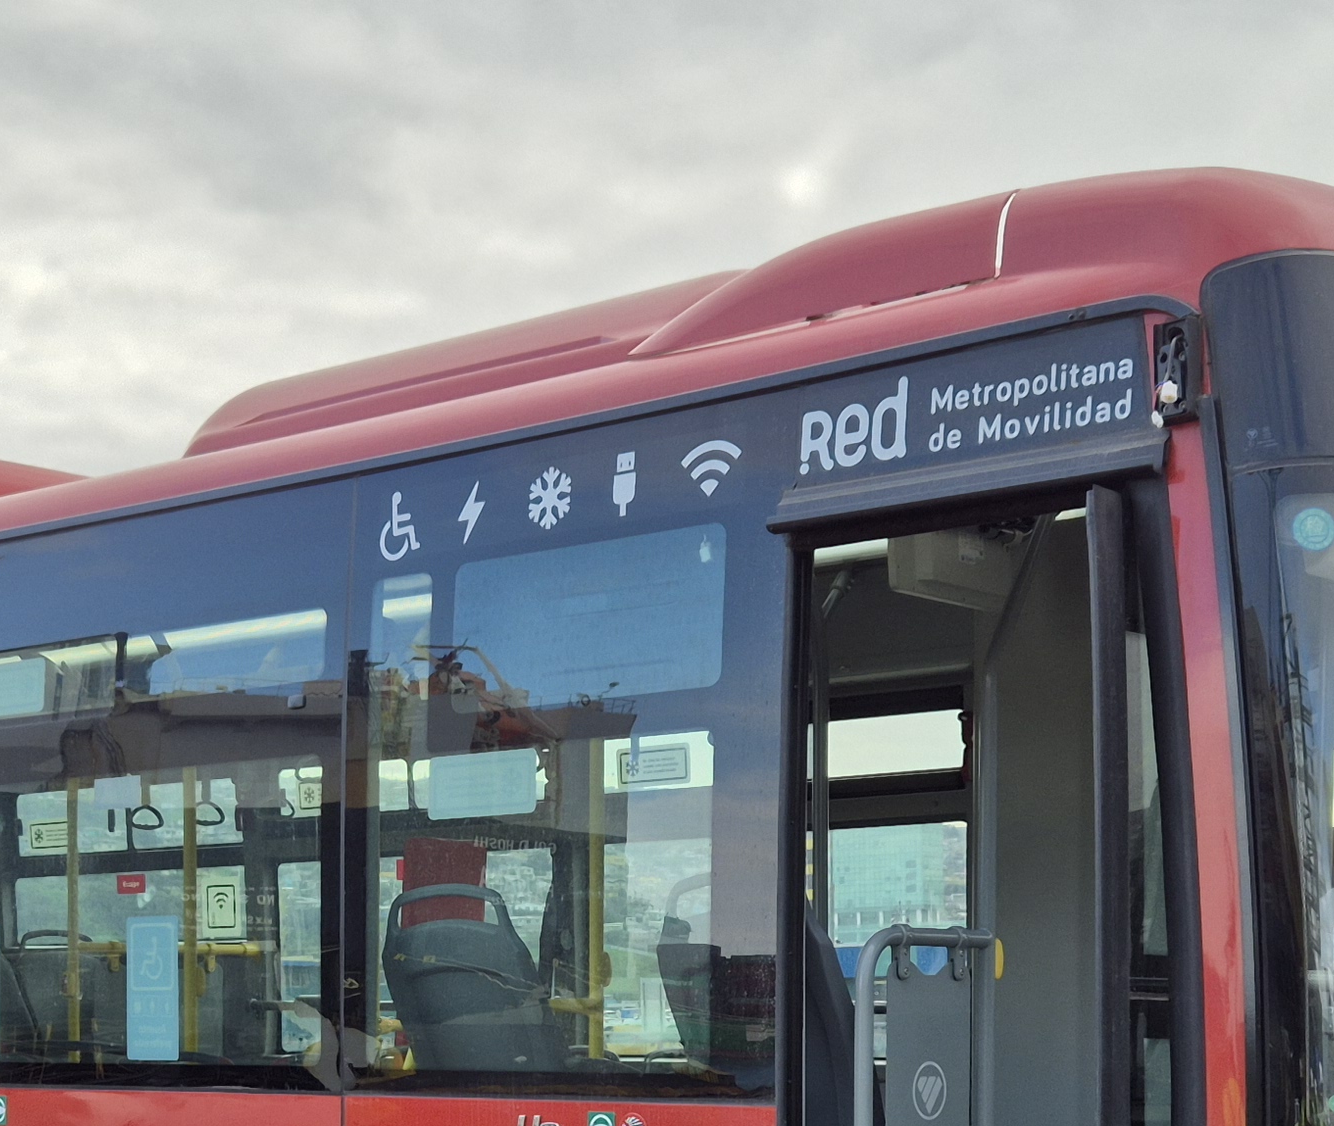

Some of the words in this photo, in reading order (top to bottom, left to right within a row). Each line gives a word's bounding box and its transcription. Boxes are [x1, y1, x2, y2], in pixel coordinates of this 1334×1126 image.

[930, 358, 1133, 415] Metropolitana
[928, 423, 962, 452] de
[978, 388, 1133, 445] Movilidad
